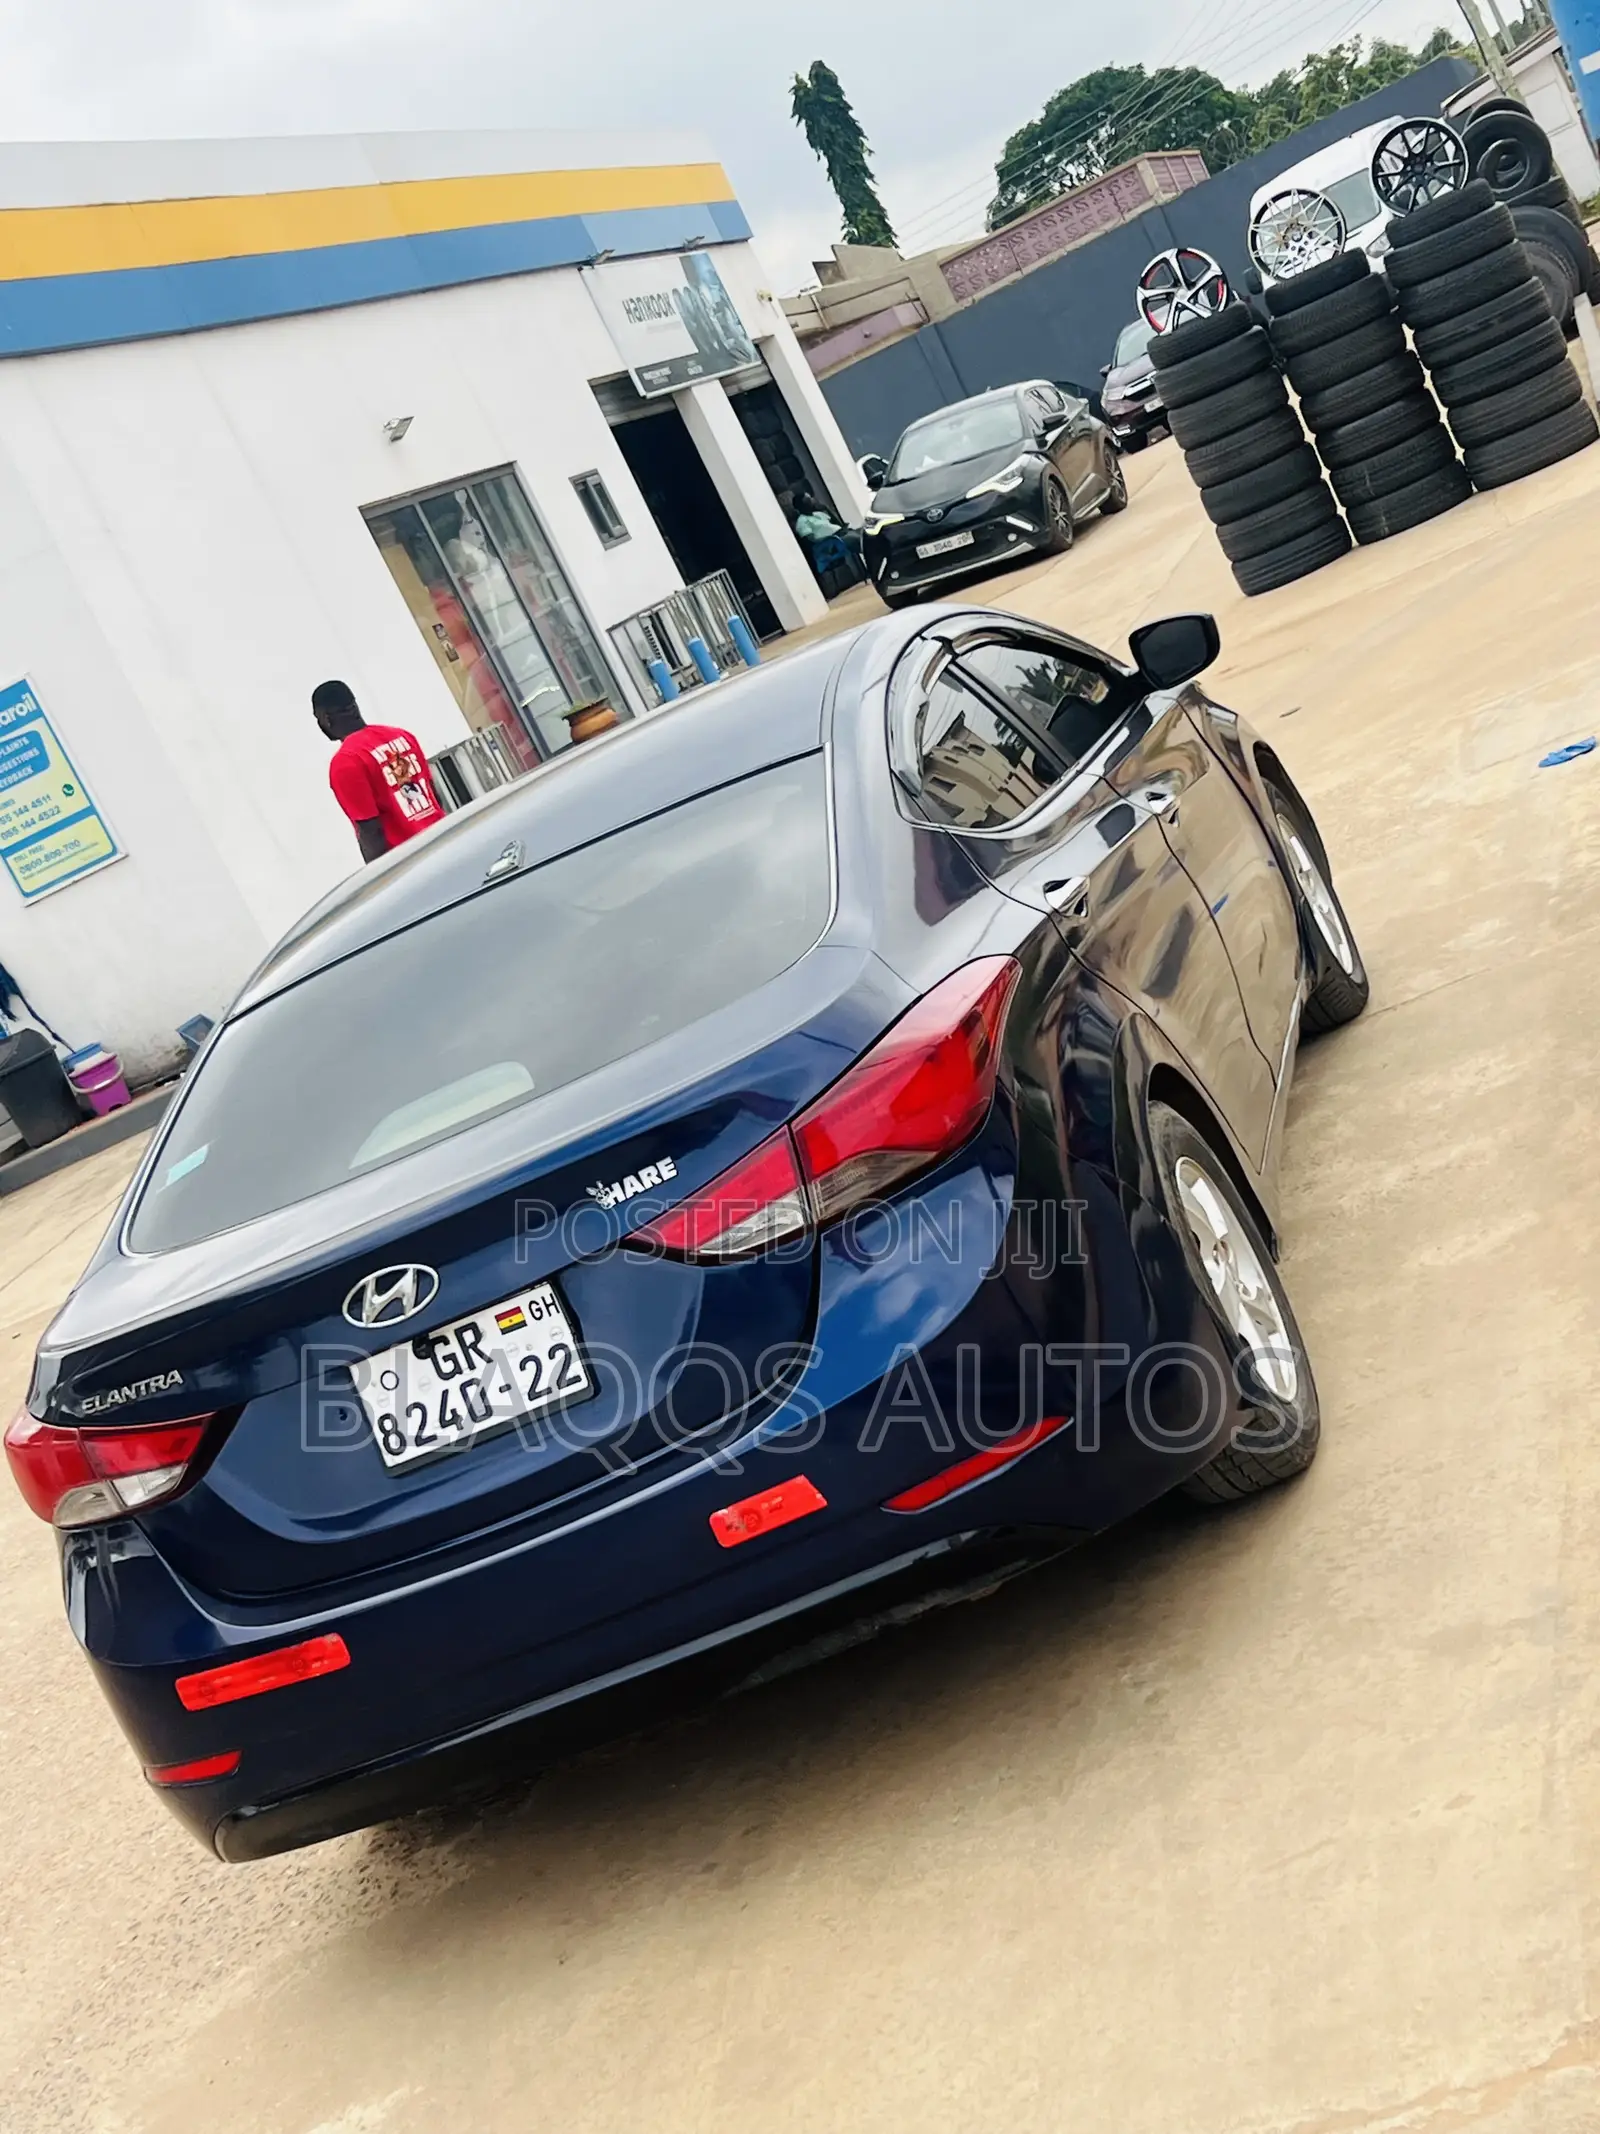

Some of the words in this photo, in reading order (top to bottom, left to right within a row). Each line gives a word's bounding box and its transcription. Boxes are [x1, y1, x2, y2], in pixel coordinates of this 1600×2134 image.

[0, 692, 37, 727] aroil
[429, 1321, 493, 1381] GR
[528, 1293, 561, 1321] GH
[81, 1369, 184, 1415] ELANTRA
